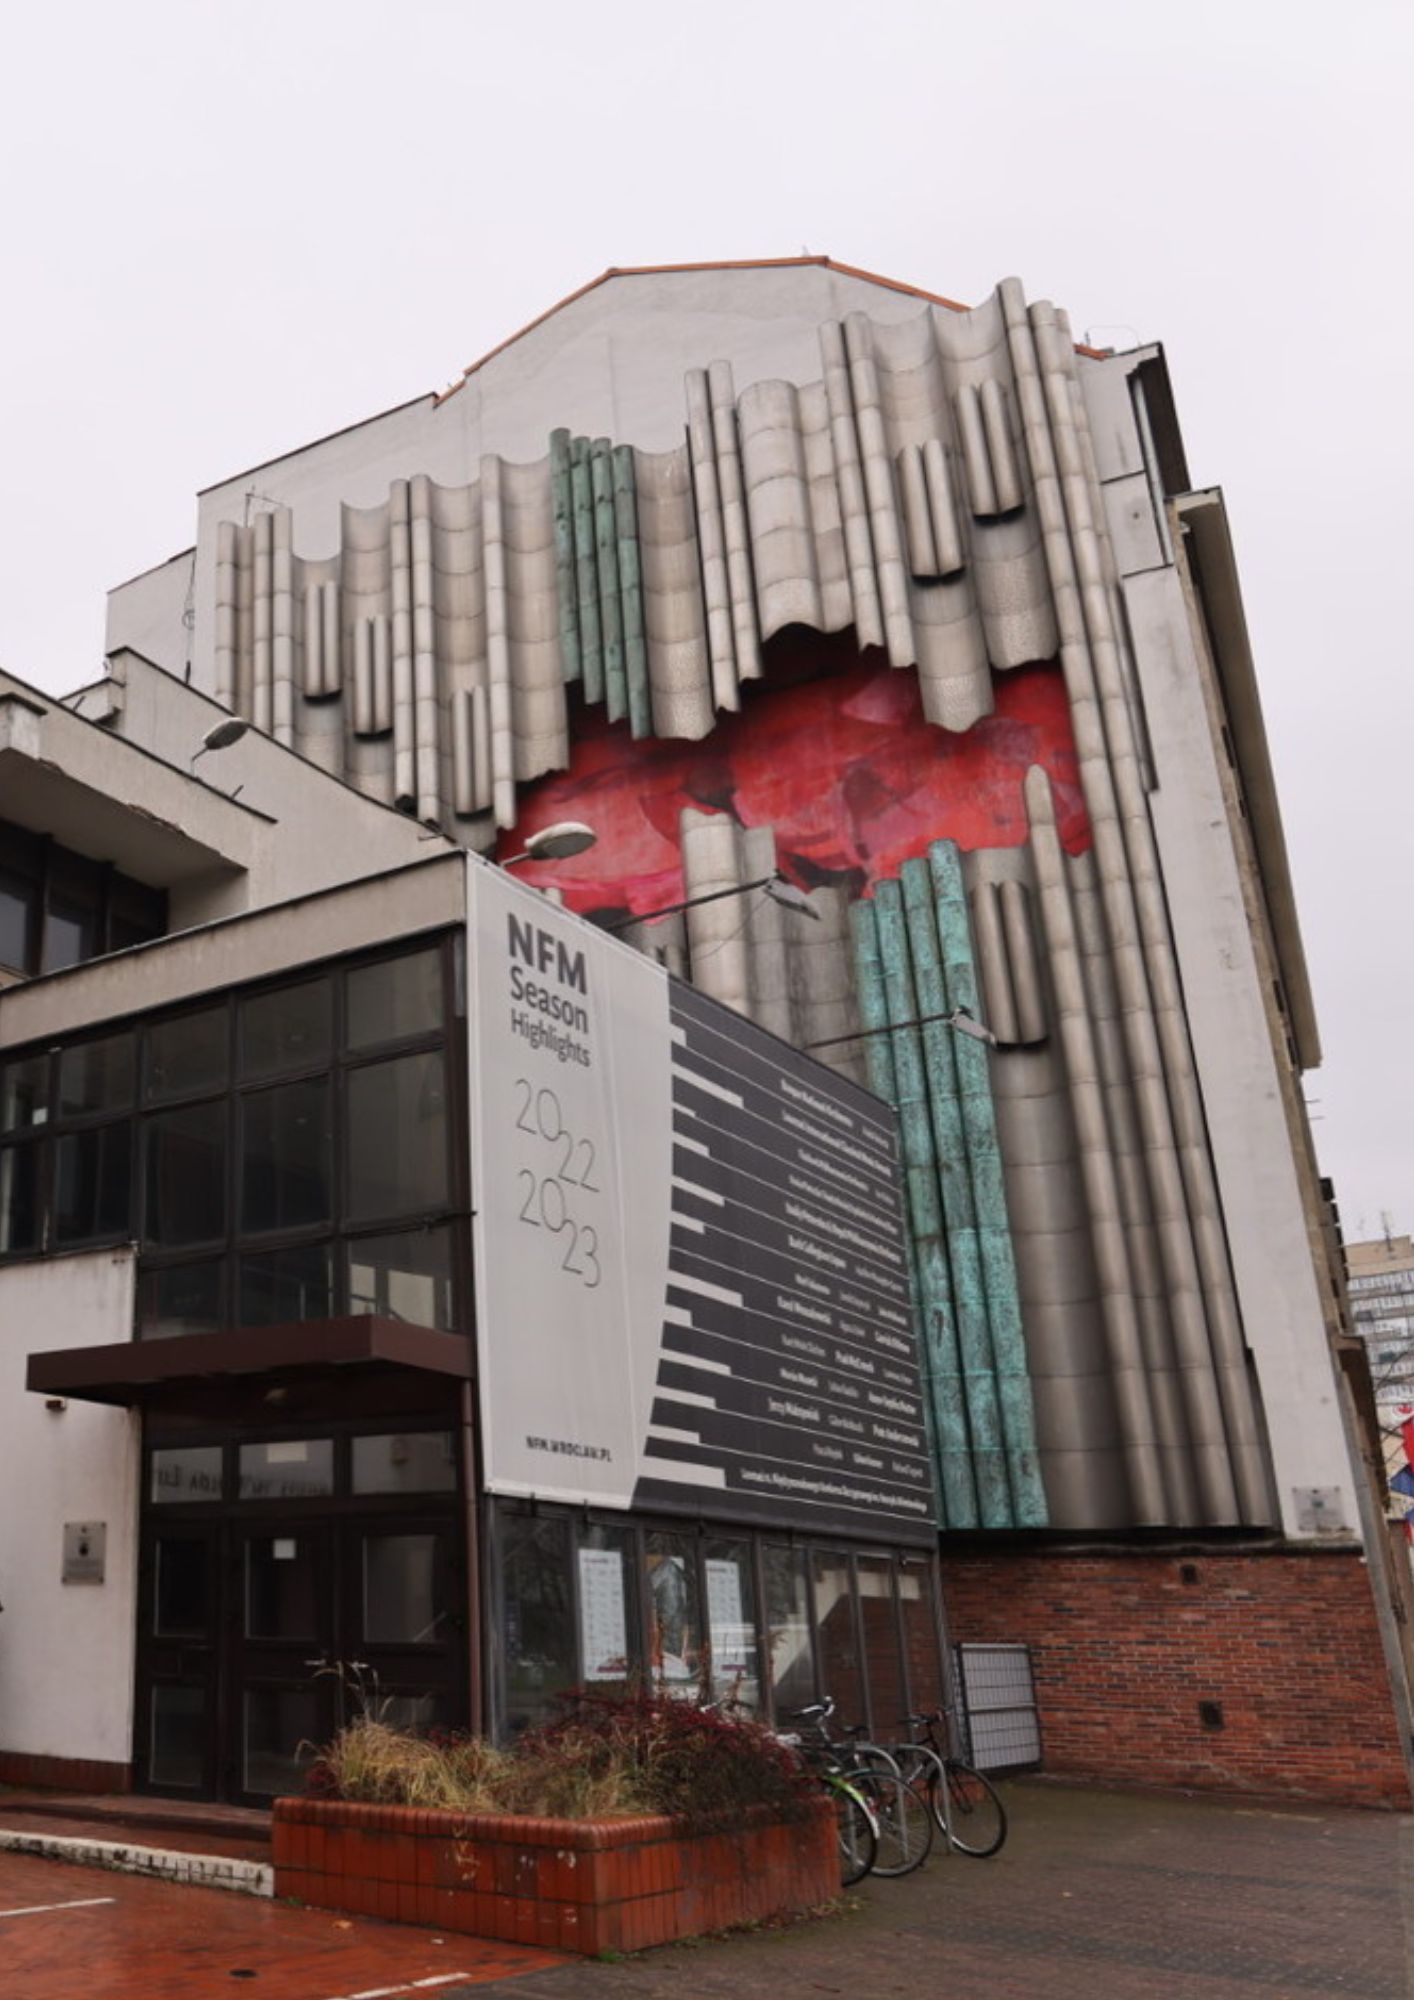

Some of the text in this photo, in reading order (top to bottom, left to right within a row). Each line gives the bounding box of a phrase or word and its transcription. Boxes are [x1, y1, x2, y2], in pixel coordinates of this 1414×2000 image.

[507, 911, 587, 996] NFM
[510, 965, 589, 1035] Season
[511, 1007, 591, 1067] Highlights
